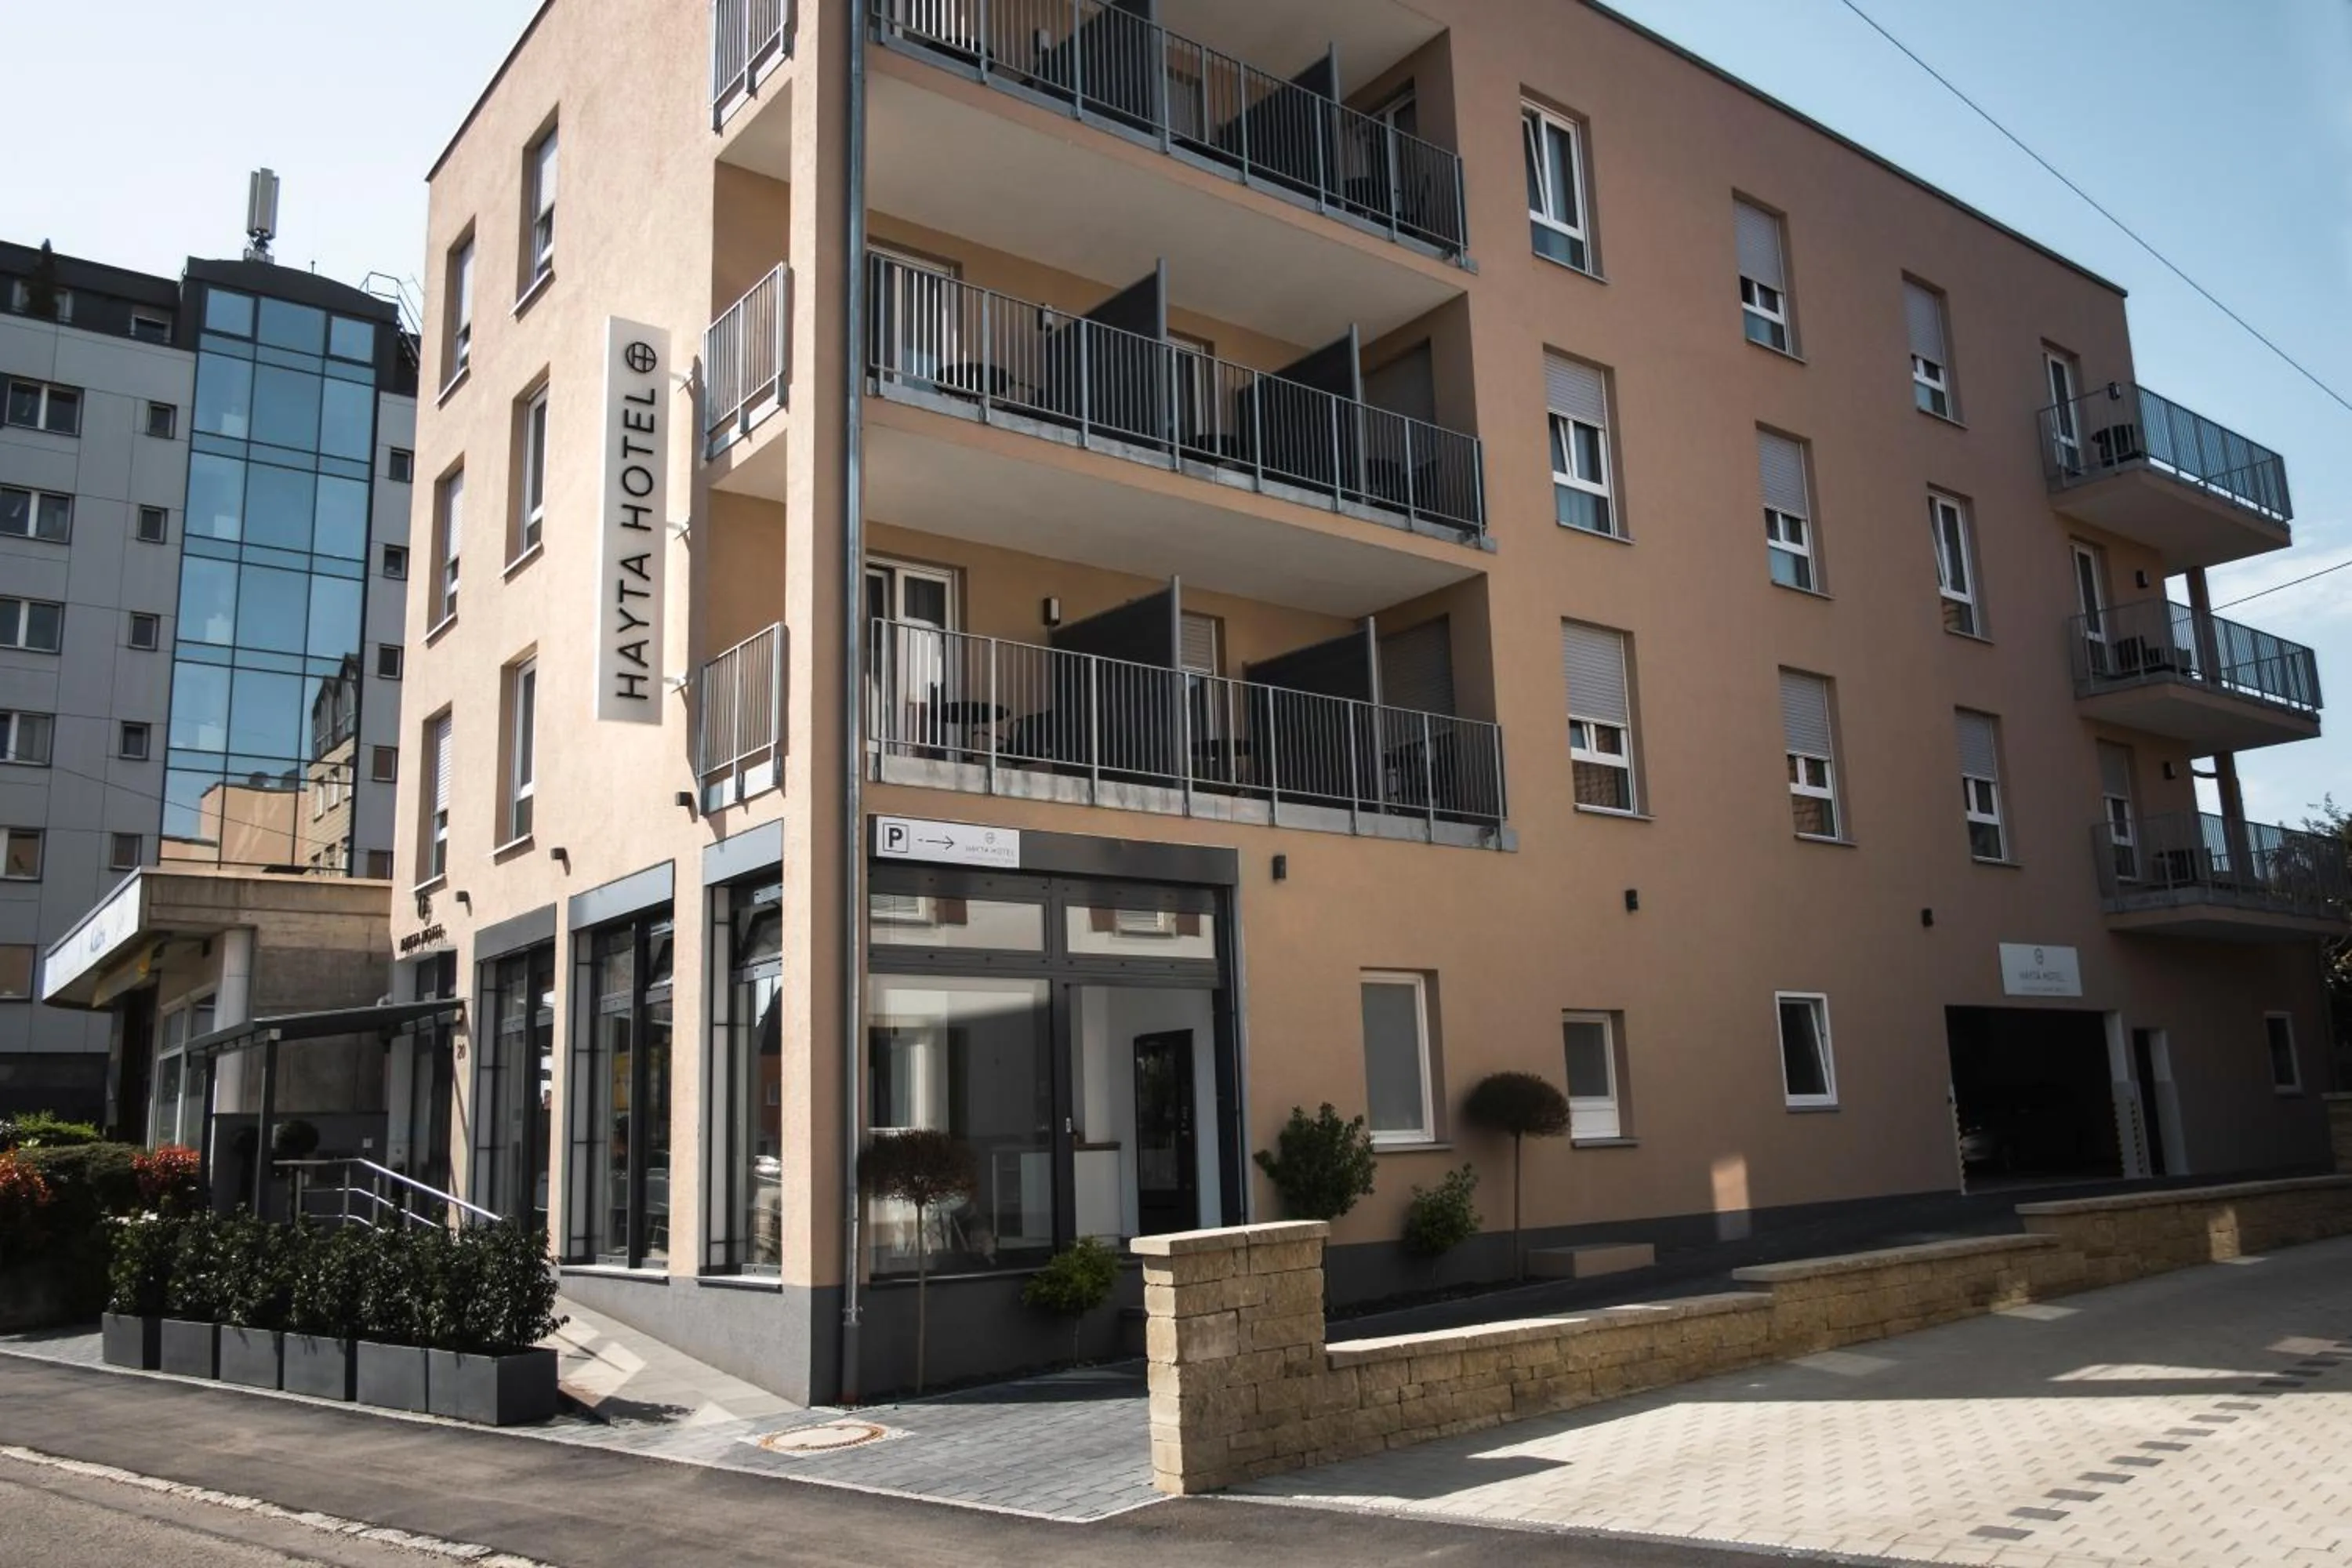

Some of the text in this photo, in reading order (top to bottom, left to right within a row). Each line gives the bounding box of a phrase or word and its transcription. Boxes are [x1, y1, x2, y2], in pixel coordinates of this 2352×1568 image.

[616, 388, 656, 701] HAYTA HOTEL
[888, 827, 903, 848] P
